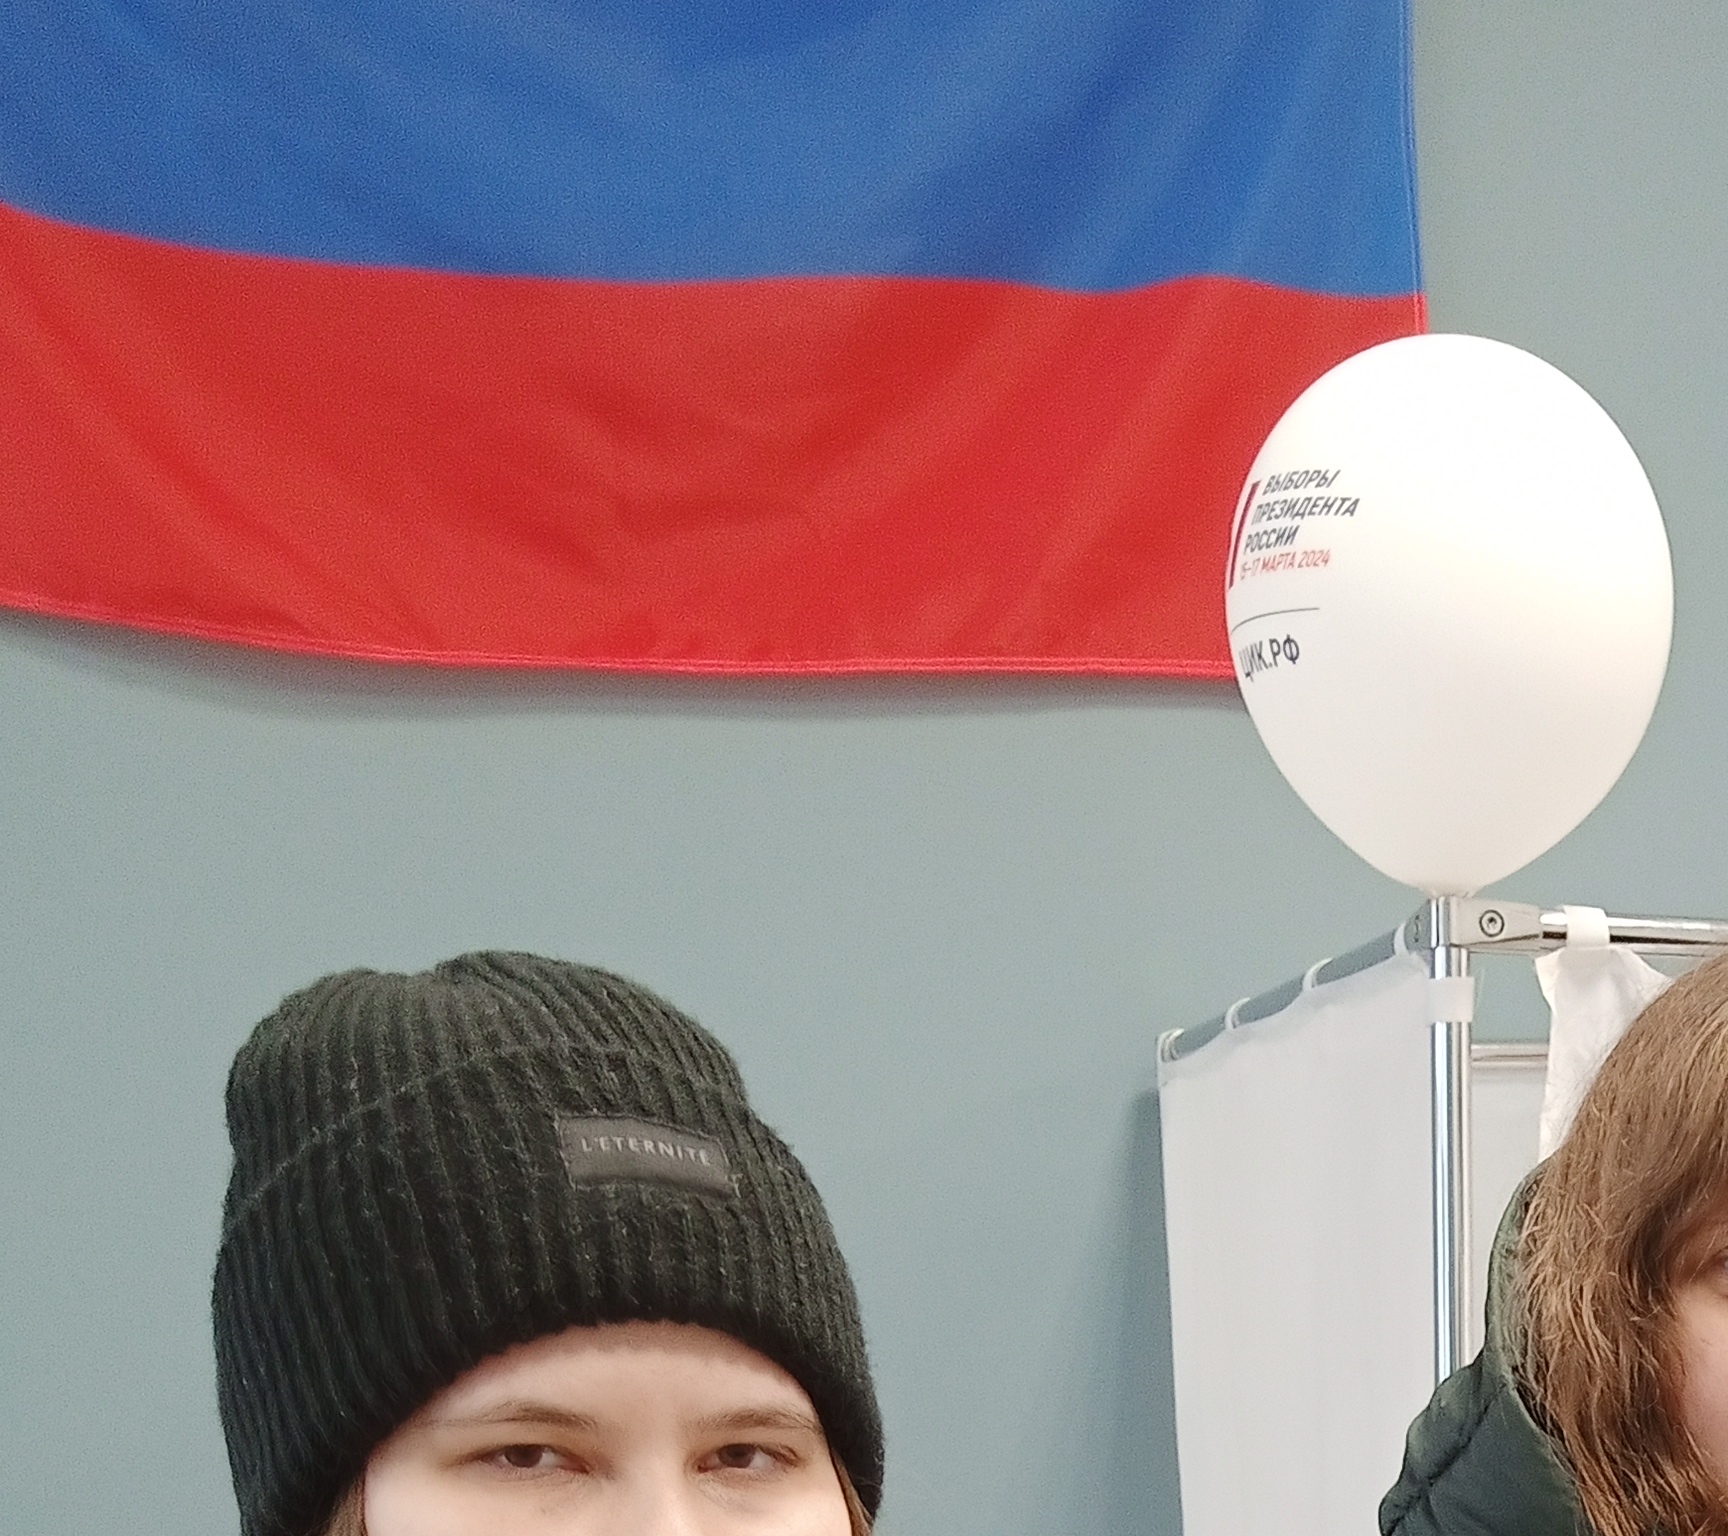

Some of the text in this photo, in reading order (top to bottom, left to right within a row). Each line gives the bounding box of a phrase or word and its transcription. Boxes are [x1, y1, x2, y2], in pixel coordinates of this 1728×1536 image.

[1262, 469, 1341, 496] ВЫБОРЫ
[1251, 496, 1360, 525] ПРЕЗИДЕНТА
[1243, 525, 1300, 555] РОССИИ
[1260, 552, 1297, 574] МАРТА
[1297, 549, 1332, 569] 2024
[1238, 634, 1300, 682] ЦИК.РФ
